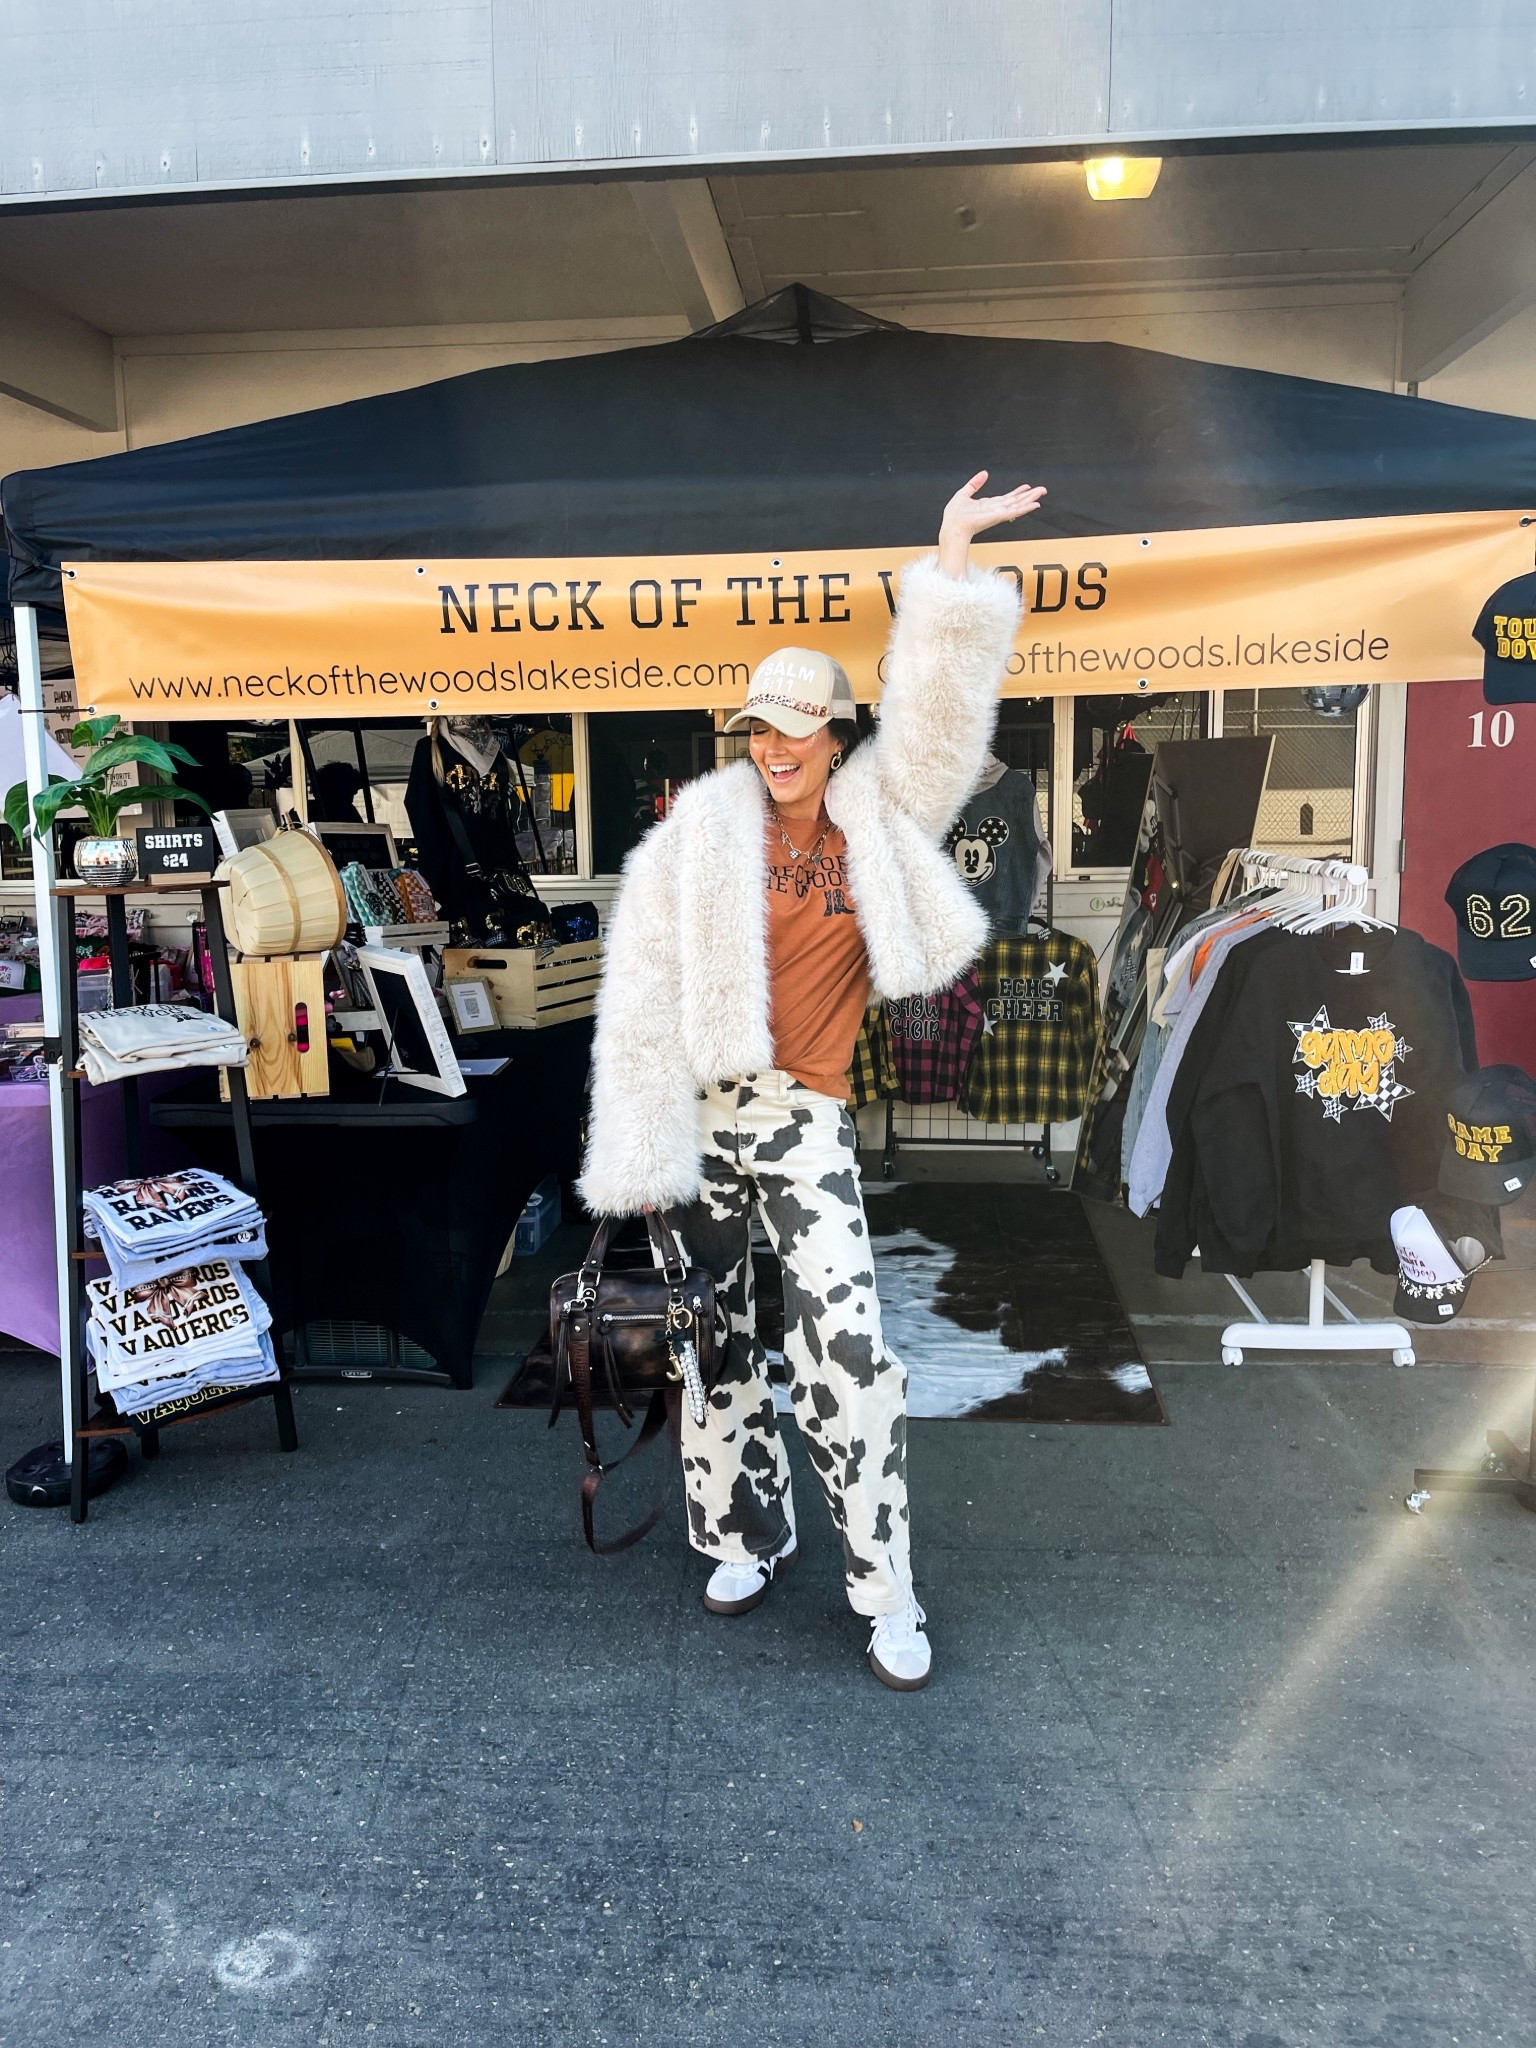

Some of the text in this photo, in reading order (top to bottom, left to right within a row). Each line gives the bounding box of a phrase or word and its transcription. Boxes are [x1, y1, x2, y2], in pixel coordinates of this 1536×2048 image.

[438, 581, 604, 633] NECK
[629, 578, 701, 629] OF
[727, 573, 850, 626] THE
[129, 656, 749, 698] www.neckofthewoodslakeside.com
[757, 661, 815, 683] PSALM
[761, 679, 794, 692] 5:11
[1467, 710, 1515, 748] 10
[144, 833, 203, 849] SHIRTS
[162, 852, 189, 868] $24
[1466, 893, 1532, 938] 62
[998, 977, 1055, 998] ECHS
[889, 997, 941, 1019] SHOW
[986, 999, 1064, 1022] CHEER
[890, 1017, 941, 1041] CHOIR
[1447, 1113, 1513, 1144] GAME
[1454, 1135, 1504, 1163] DAY
[124, 1194, 236, 1231] RAVENS
[118, 1303, 250, 1356] VAQUEROS
